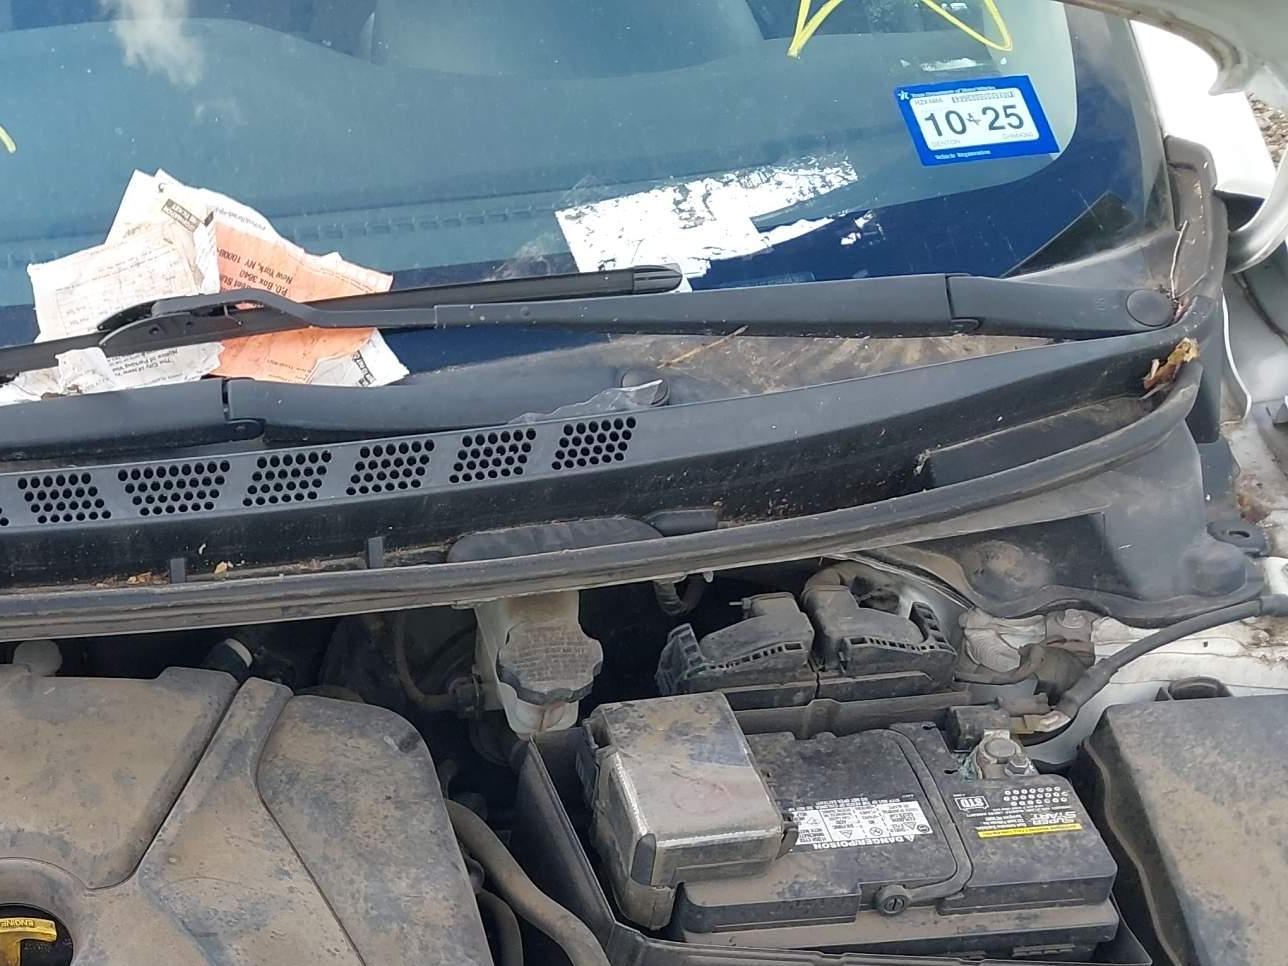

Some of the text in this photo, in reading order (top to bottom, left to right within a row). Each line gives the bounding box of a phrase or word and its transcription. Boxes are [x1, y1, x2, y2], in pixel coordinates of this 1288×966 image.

[925, 104, 1024, 137] 10 25
[244, 259, 257, 270] NY
[275, 271, 293, 284] New
[1032, 817, 1075, 826] SUPER
